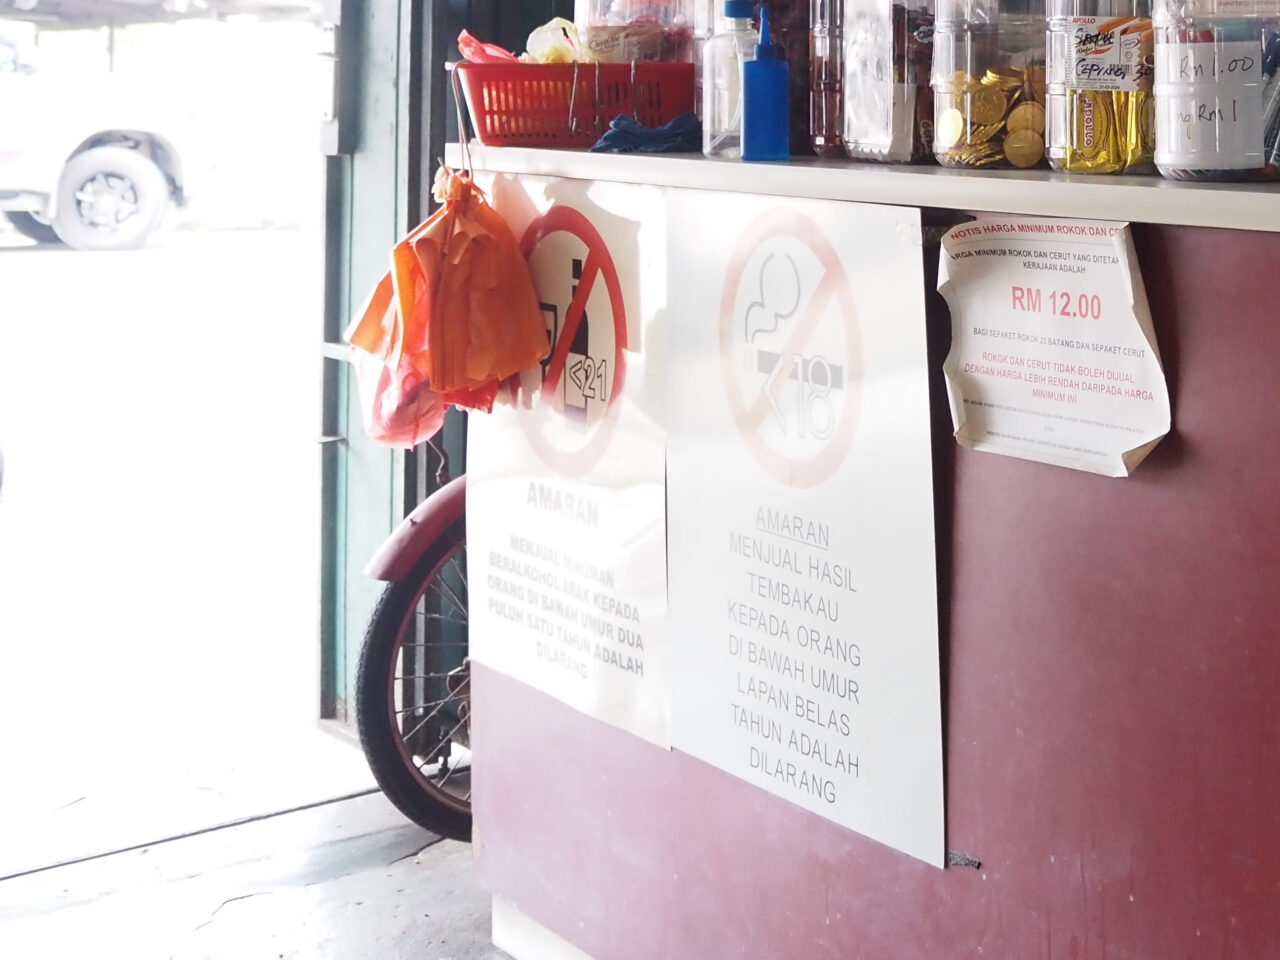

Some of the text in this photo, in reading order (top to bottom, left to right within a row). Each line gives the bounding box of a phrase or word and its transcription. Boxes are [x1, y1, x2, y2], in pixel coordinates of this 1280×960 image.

[1072, 17, 1096, 25] APOLLO
[950, 224, 1107, 240] NOTIS HARGA MINIMUM ROKOK DAN
[974, 248, 1007, 259] MINIMUM
[1008, 248, 1033, 258] ROKOK
[1033, 250, 1048, 259] DAN
[1049, 251, 1071, 261] CERUT
[1072, 252, 1091, 262] YANG
[1023, 260, 1086, 274] KERAJAAN ADALAH
[1011, 286, 1102, 320] RM 12.00
[973, 327, 989, 337] BAGI
[989, 329, 1016, 341] SEPAKET
[1017, 332, 1039, 343] ROKOK
[1047, 338, 1075, 349] BATANG
[1076, 341, 1090, 351] DAN
[1091, 342, 1121, 355] SEPAKET
[1122, 347, 1146, 359] CERUT
[964, 362, 1154, 402] DENGAN HARGA LEBIH RENDAH DARIPADA HARGA
[982, 352, 1135, 384] ROKOK DAN CERUT TIDAK BOLEH DIJUAL
[1032, 388, 1077, 405] MINIMUM INI
[526, 480, 600, 528] AMARAN
[755, 505, 830, 548] AMARAN
[509, 533, 560, 566] MENJUAL
[729, 531, 858, 592] MENJUAL HASIL
[487, 574, 645, 652] ORANG DI BAWAH UMUR DUA
[592, 592, 641, 625] KEPADA
[747, 572, 840, 623] TEMBAKAU
[488, 597, 645, 678] PULUH SATU TAHUN ADALAH
[727, 599, 862, 668] KEPADA ORANG
[535, 640, 588, 680] DILARANG
[728, 634, 860, 704] DI BAWAH UMUR
[737, 671, 850, 737] LAPAN BELAS
[731, 703, 860, 779] TAHUN ADALAH
[750, 746, 836, 804] DILARANG
